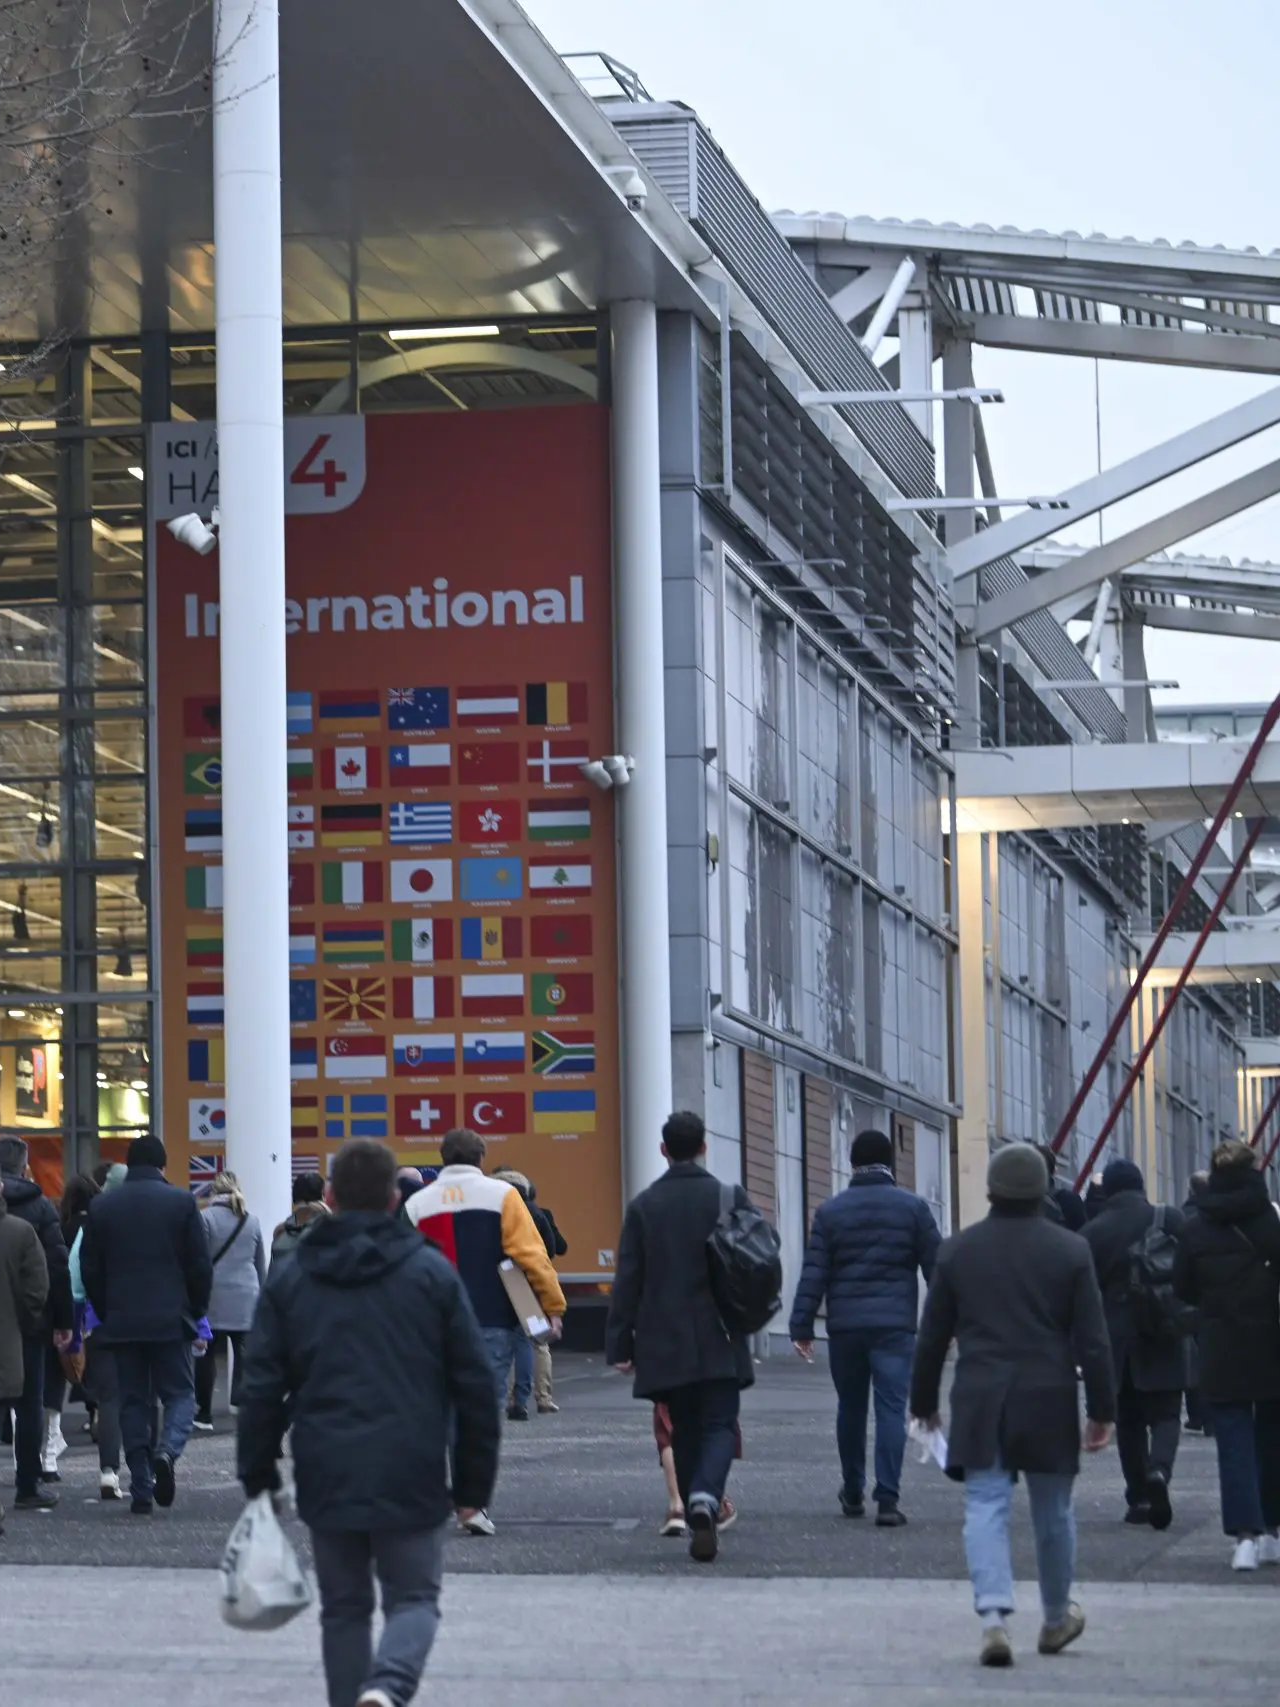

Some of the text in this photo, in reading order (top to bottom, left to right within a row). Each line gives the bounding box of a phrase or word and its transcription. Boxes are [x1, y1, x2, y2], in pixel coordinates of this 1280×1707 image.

[166, 440, 197, 458] ICI
[290, 434, 347, 497] 4
[168, 470, 219, 505] HA
[184, 575, 584, 637] Iernational
